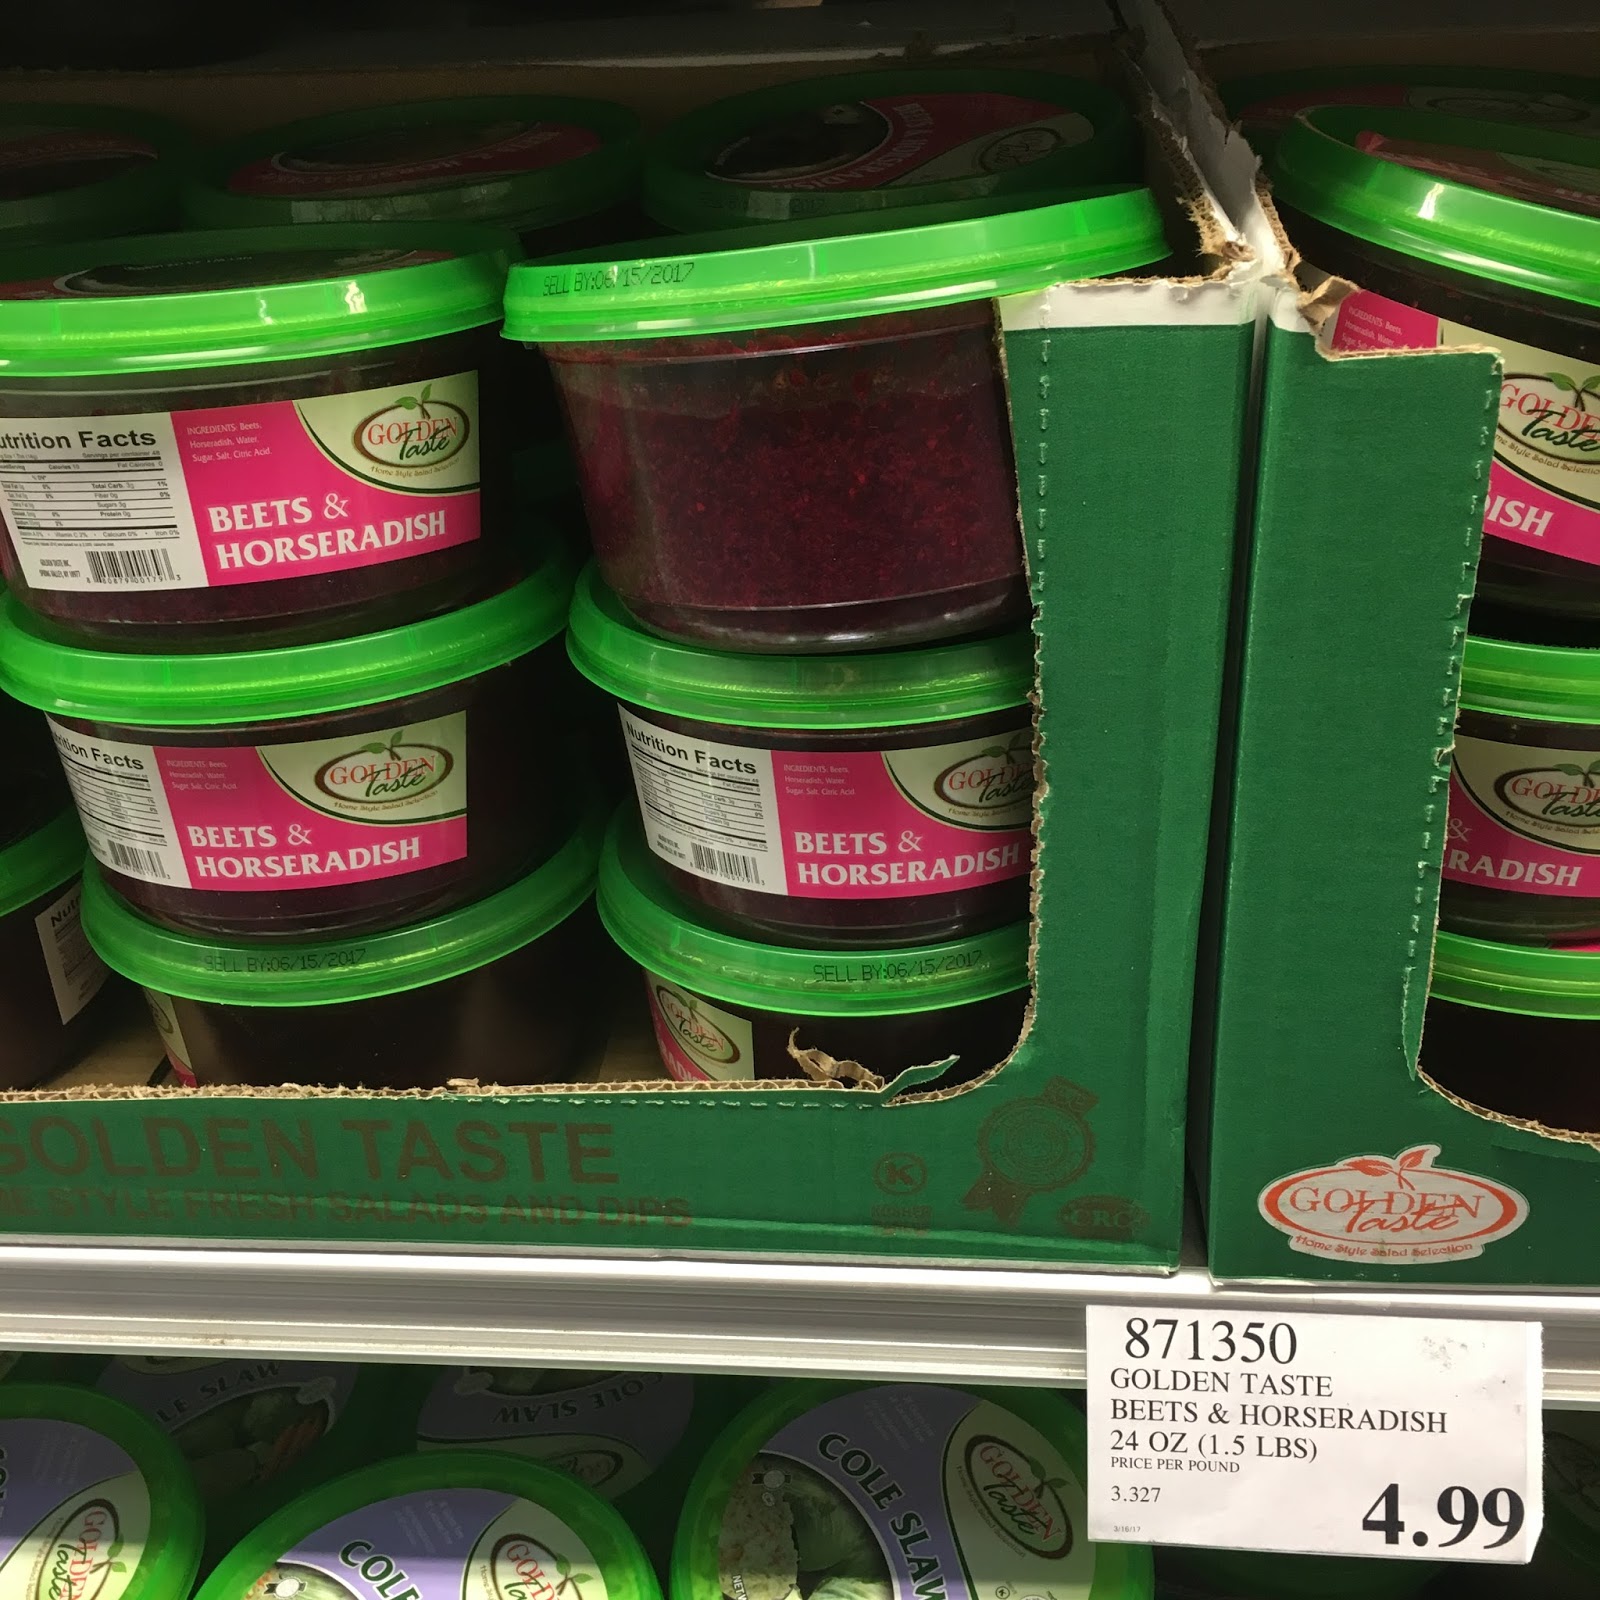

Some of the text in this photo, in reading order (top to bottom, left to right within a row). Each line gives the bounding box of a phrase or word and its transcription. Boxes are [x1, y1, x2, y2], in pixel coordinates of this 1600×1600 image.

[543, 275, 569, 297] SELL
[1501, 382, 1600, 443] GOLDE
[0, 429, 157, 450] utrition Facts
[367, 416, 458, 446] GOLDEN
[398, 425, 451, 461] Taste
[1559, 463, 1600, 477] Selectio
[208, 492, 349, 533] BEETS &
[214, 509, 447, 570] HORSERADISH
[91, 747, 145, 771] Facts
[626, 721, 757, 775] Nutrition Facts
[329, 754, 436, 786] GOLDEN
[361, 762, 428, 798] Taste
[1542, 790, 1600, 818] Tast
[187, 823, 313, 848] BEETS &
[794, 830, 923, 856] BEETS &
[1448, 818, 1472, 843] &
[194, 836, 421, 879] HORSERADISH
[797, 842, 1020, 886] HORSERADISH
[1447, 849, 1583, 887] RADISH
[205, 948, 367, 973] SELL BY:06/15/2017
[813, 949, 983, 983] SELL BY:06/15/2017
[342, 1118, 621, 1186] TASTE
[47, 1186, 173, 1220] STYLE
[181, 1189, 315, 1222] FRESH
[328, 1191, 488, 1226] SALADS
[498, 1193, 585, 1227] AND
[597, 1194, 693, 1229] DIPS
[1289, 1186, 1486, 1220] GOLDEN
[1340, 1196, 1460, 1234] Taste
[1295, 1234, 1474, 1258] Home Style Salad Selection
[1124, 1316, 1299, 1365] 871350
[1110, 1367, 1334, 1398] GOLDEN TASTE
[156, 1397, 190, 1424] LE
[1110, 1398, 1448, 1434] BEETS & HORSERADISH
[1110, 1429, 1319, 1465] 24 OZ (1.5 LBS)
[1110, 1456, 1241, 1474] PRICE PER POUND
[816, 1432, 906, 1513] COLE
[979, 1444, 1063, 1542] GOLDEN
[983, 1473, 1048, 1535] Taste
[1110, 1485, 1162, 1503] 3.327
[1113, 1525, 1142, 1534] 3/16/17
[1361, 1482, 1527, 1552] 4.99
[59, 1508, 107, 1600] GOLDE
[506, 1543, 556, 1600] GOLD
